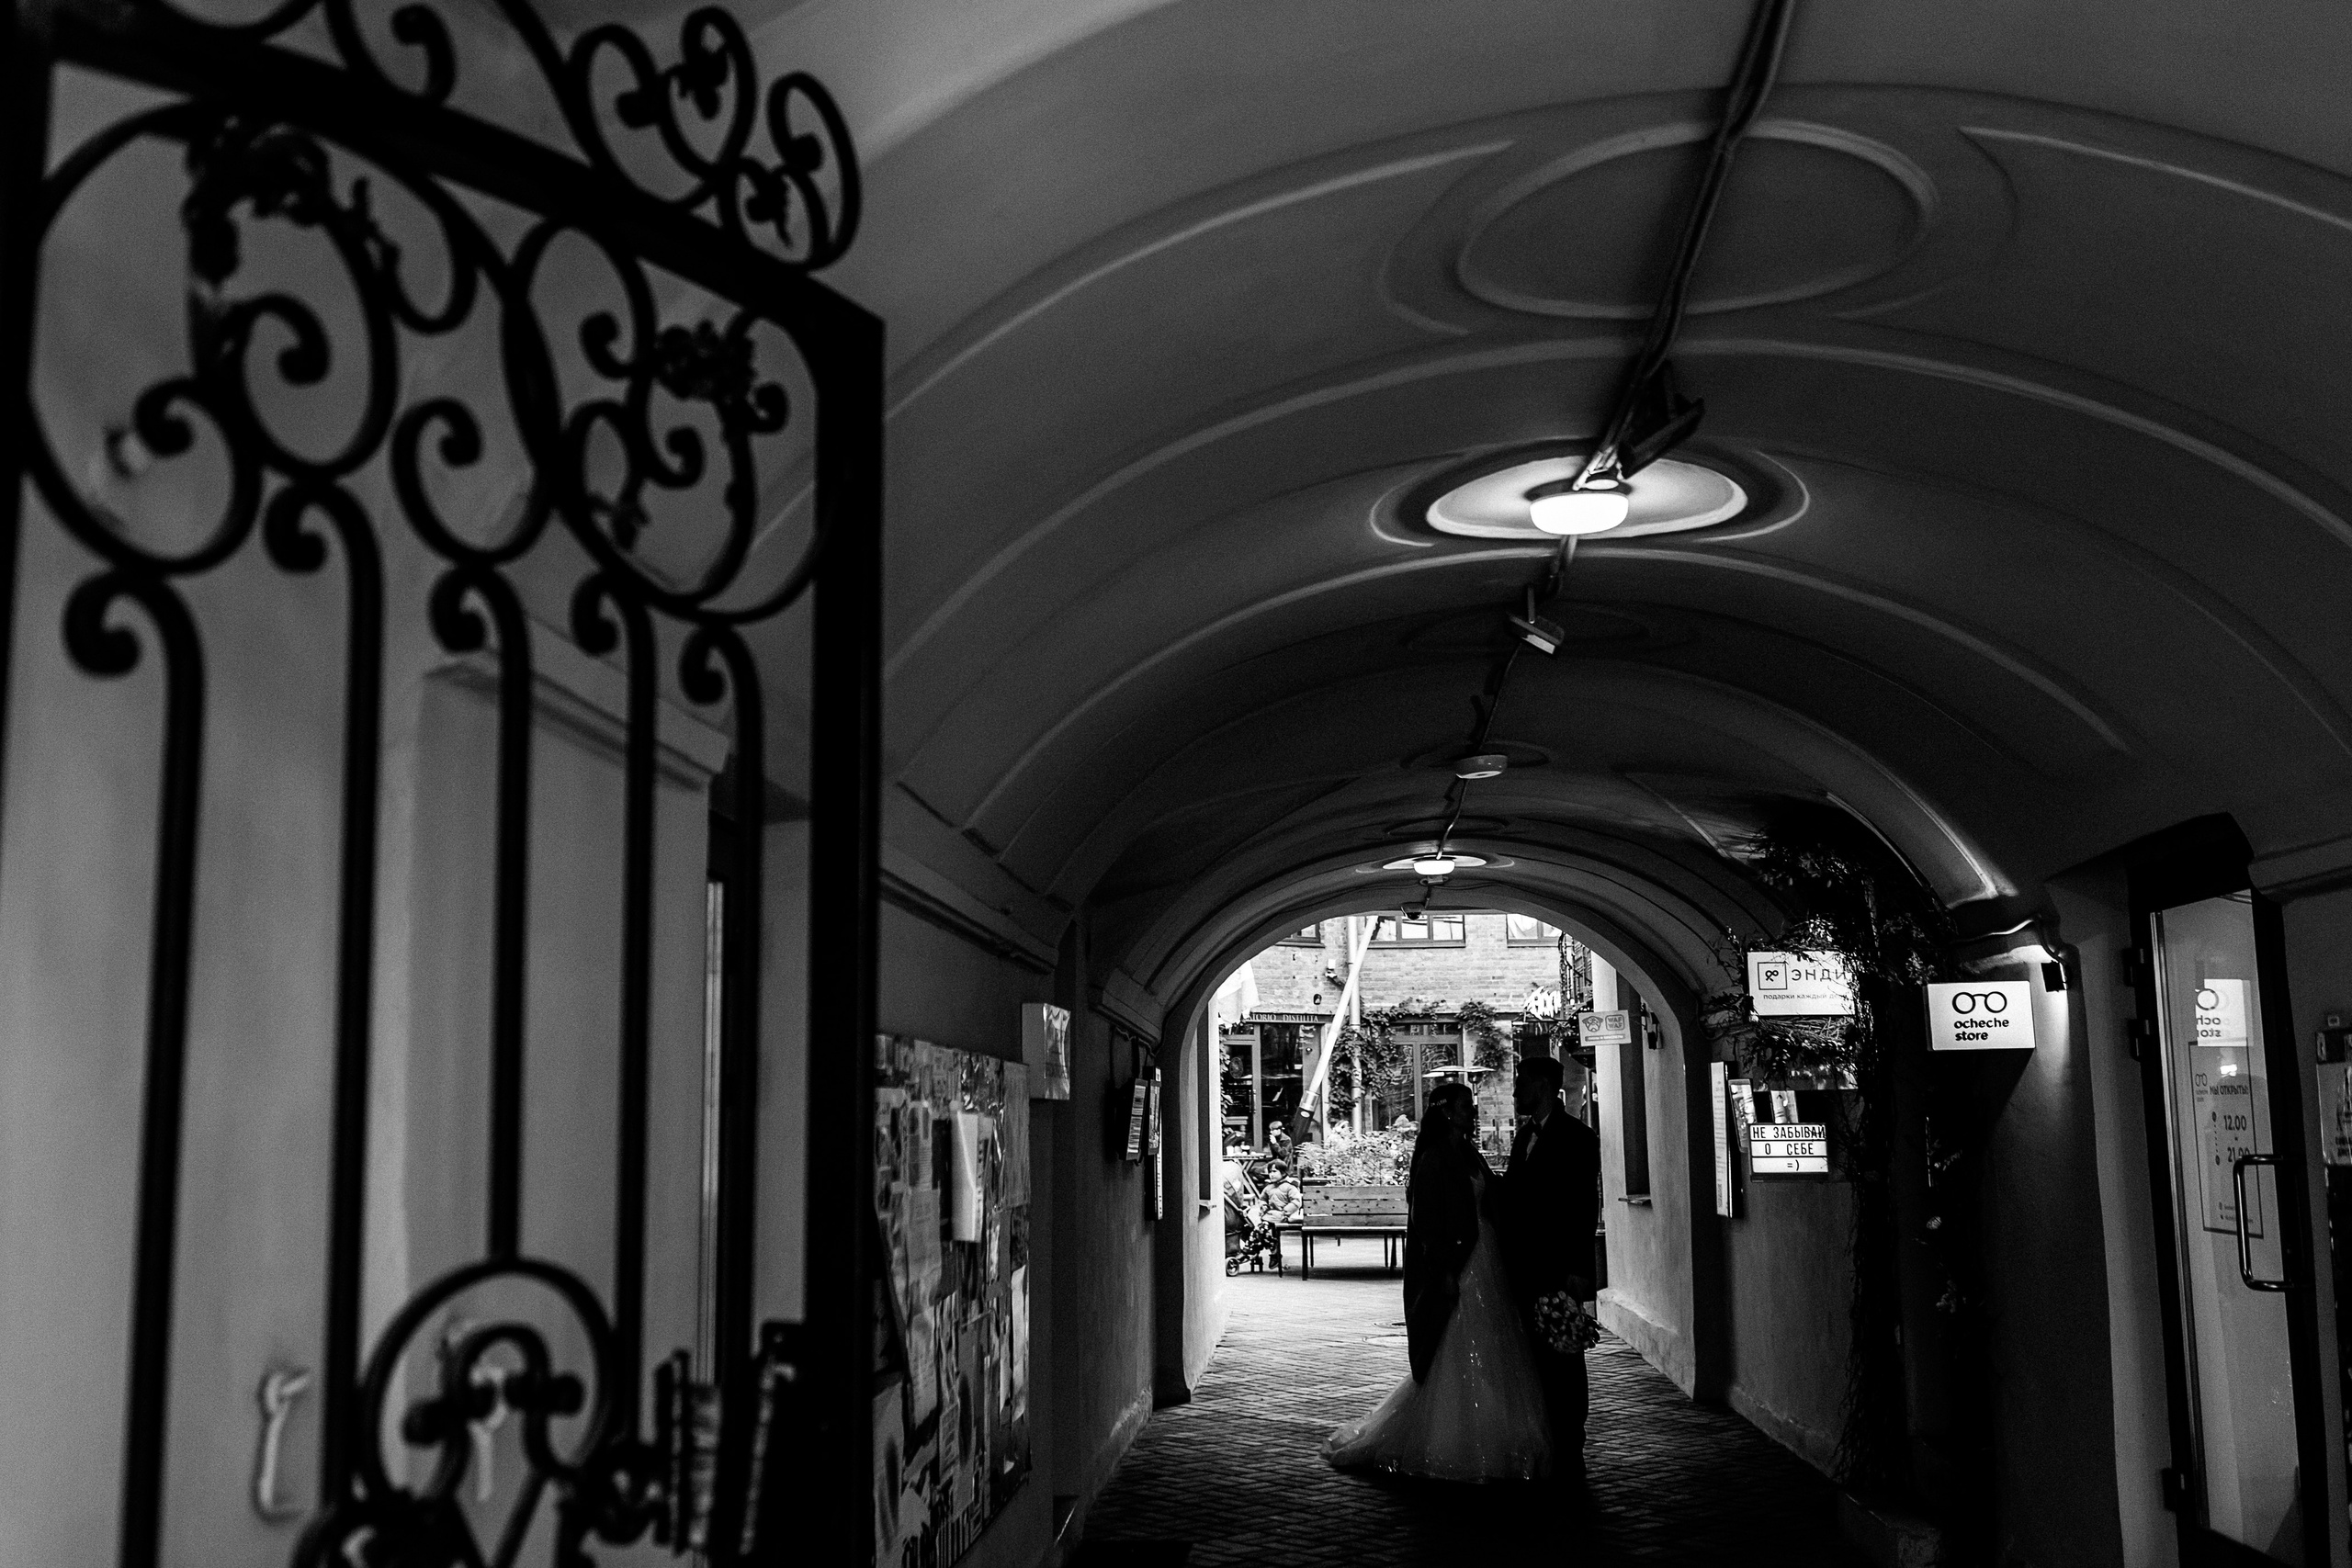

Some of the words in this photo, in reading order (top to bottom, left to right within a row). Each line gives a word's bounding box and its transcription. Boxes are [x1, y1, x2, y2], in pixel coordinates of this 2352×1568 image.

[1792, 968, 1847, 982] ЭНДИ
[1953, 1017, 2010, 1029] ocheche
[1954, 1031, 1989, 1041] store
[2223, 1114, 2247, 1131] 12.00
[1752, 1126, 1767, 1139] НЕ
[1765, 1144, 1771, 1155] О
[1786, 1142, 1815, 1156] СЕБЕ
[1787, 1159, 1800, 1171] =)
